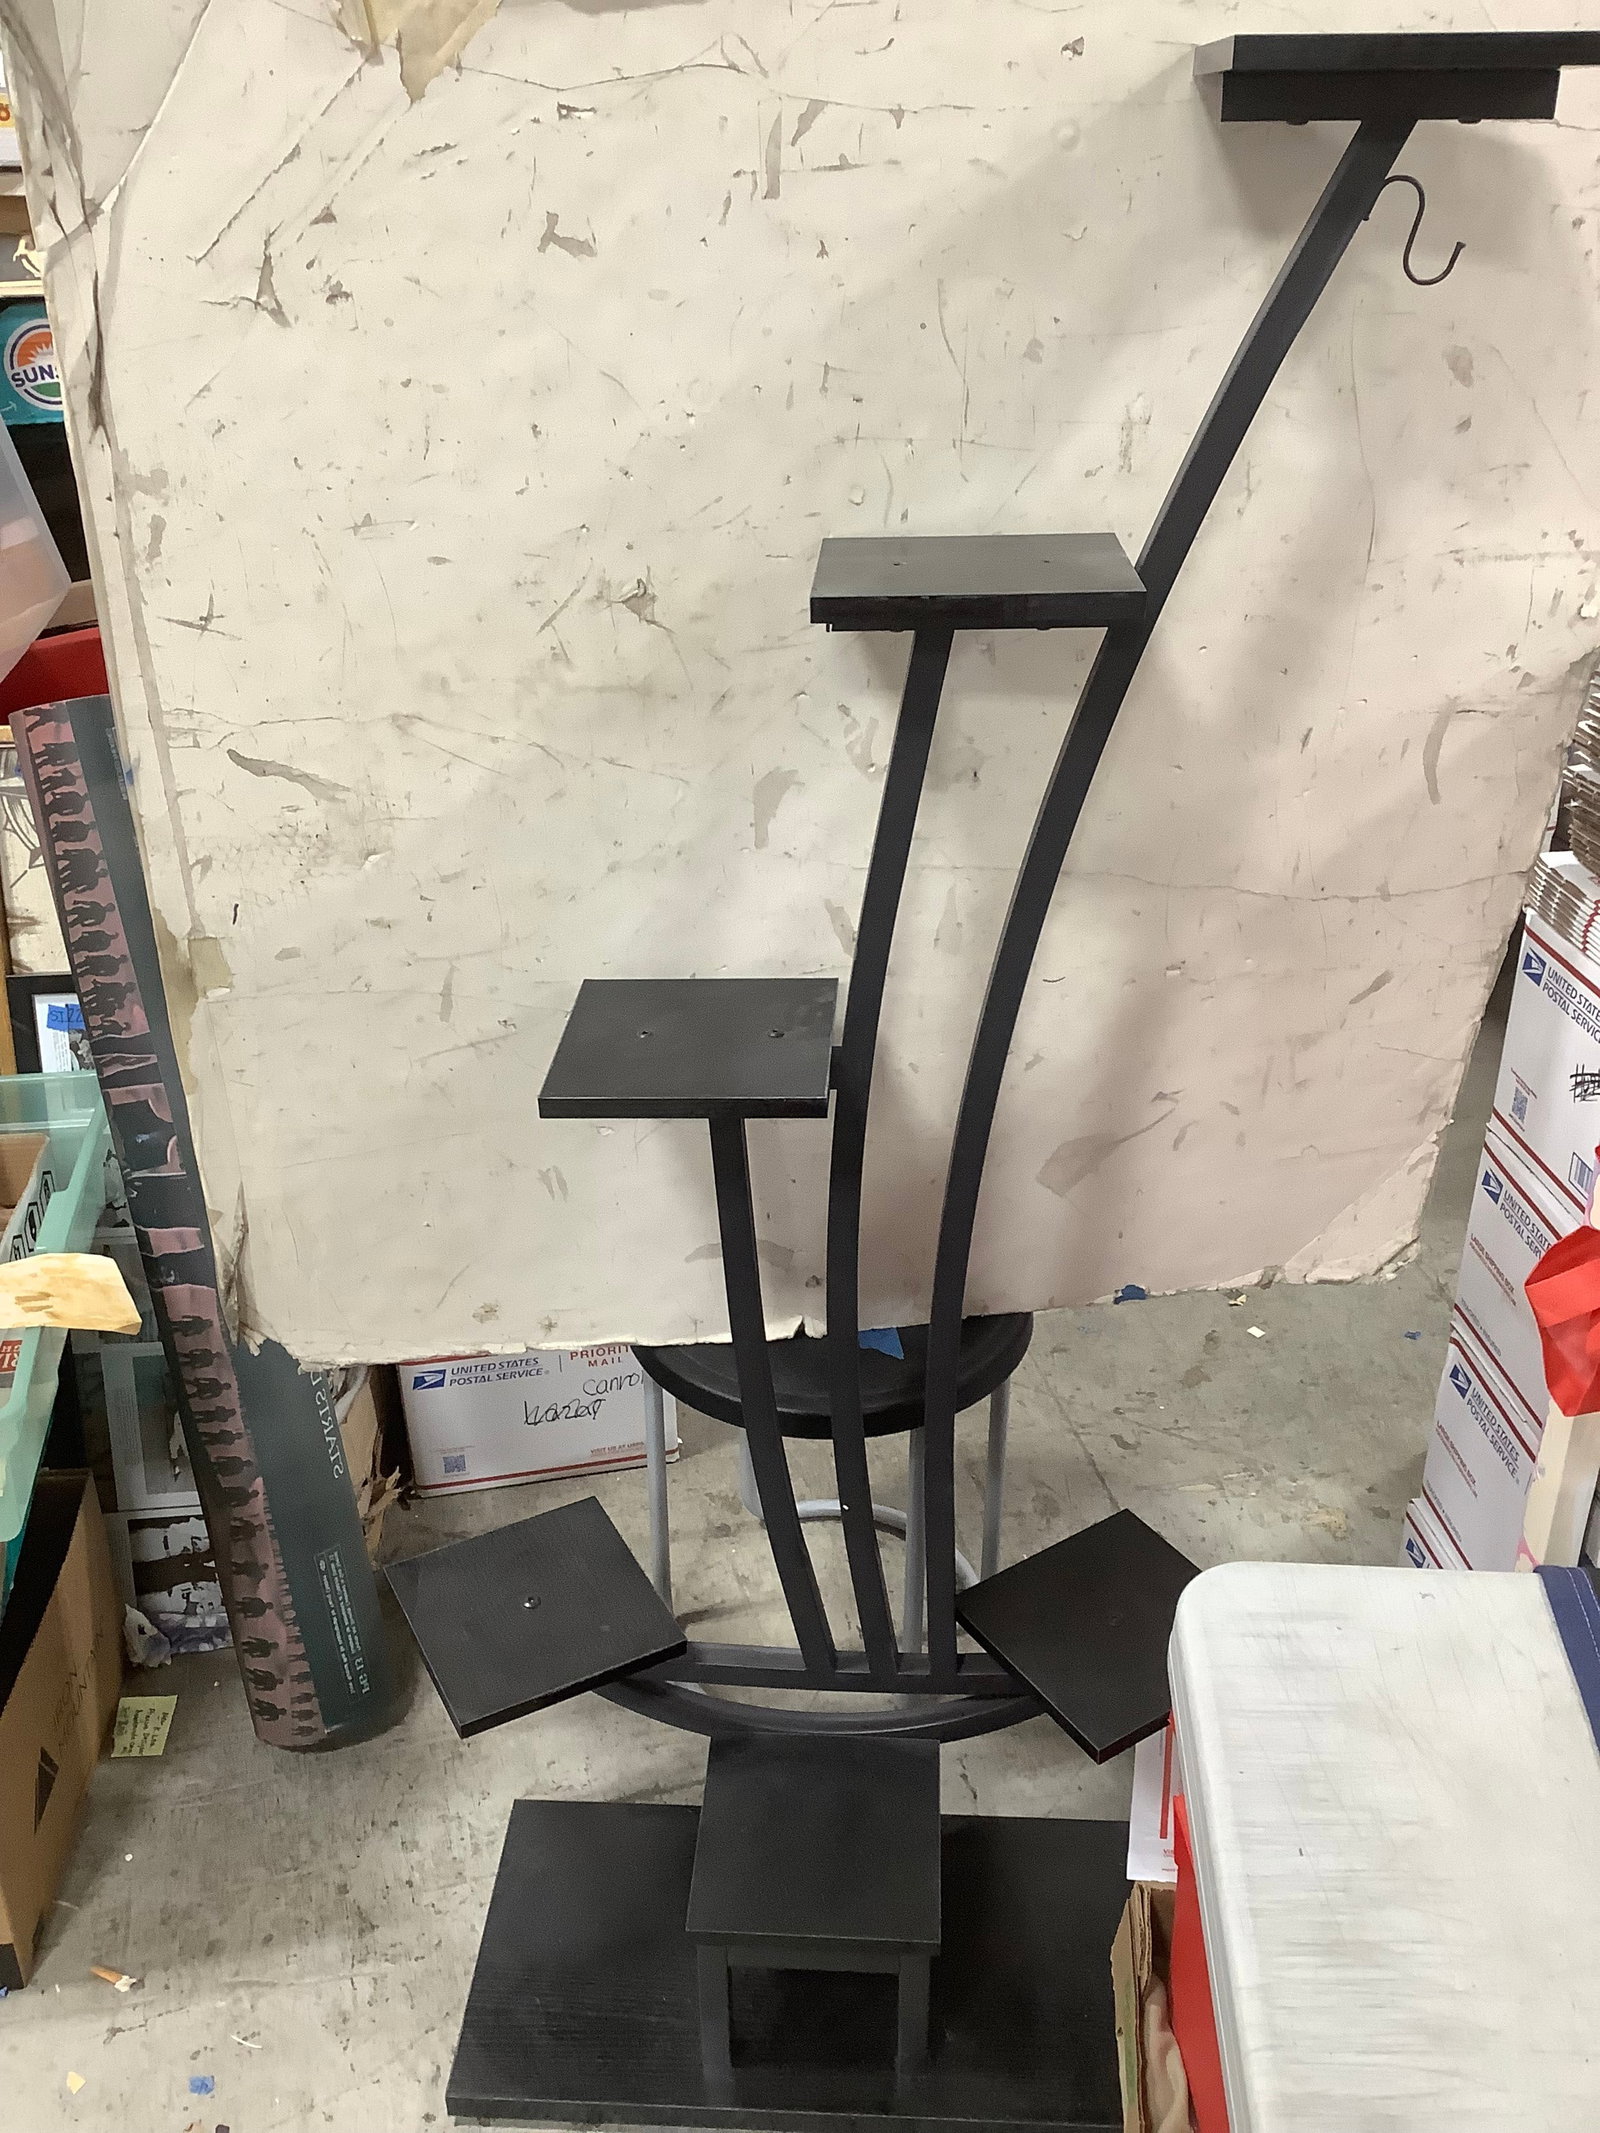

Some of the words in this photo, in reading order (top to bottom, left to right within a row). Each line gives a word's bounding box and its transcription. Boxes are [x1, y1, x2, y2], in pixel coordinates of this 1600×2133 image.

[11, 364, 59, 388] SUN
[1542, 981, 1570, 1016] POSTAL
[1571, 1008, 1600, 1044] SERVIC
[1548, 966, 1578, 999] UNITED
[1577, 994, 1600, 1023] STATE
[1500, 1202, 1525, 1240] POSTAL
[1504, 1189, 1531, 1226] UNITED
[450, 1374, 493, 1387] POSTAL
[496, 1367, 544, 1382] SERVICE
[451, 1362, 496, 1376] UNITED
[498, 1357, 540, 1370] STATES
[1466, 1398, 1490, 1438] POSTAL
[1489, 1434, 1518, 1479] SERVICE
[1471, 1387, 1497, 1426] UNITED
[1496, 1424, 1520, 1462] STATES
